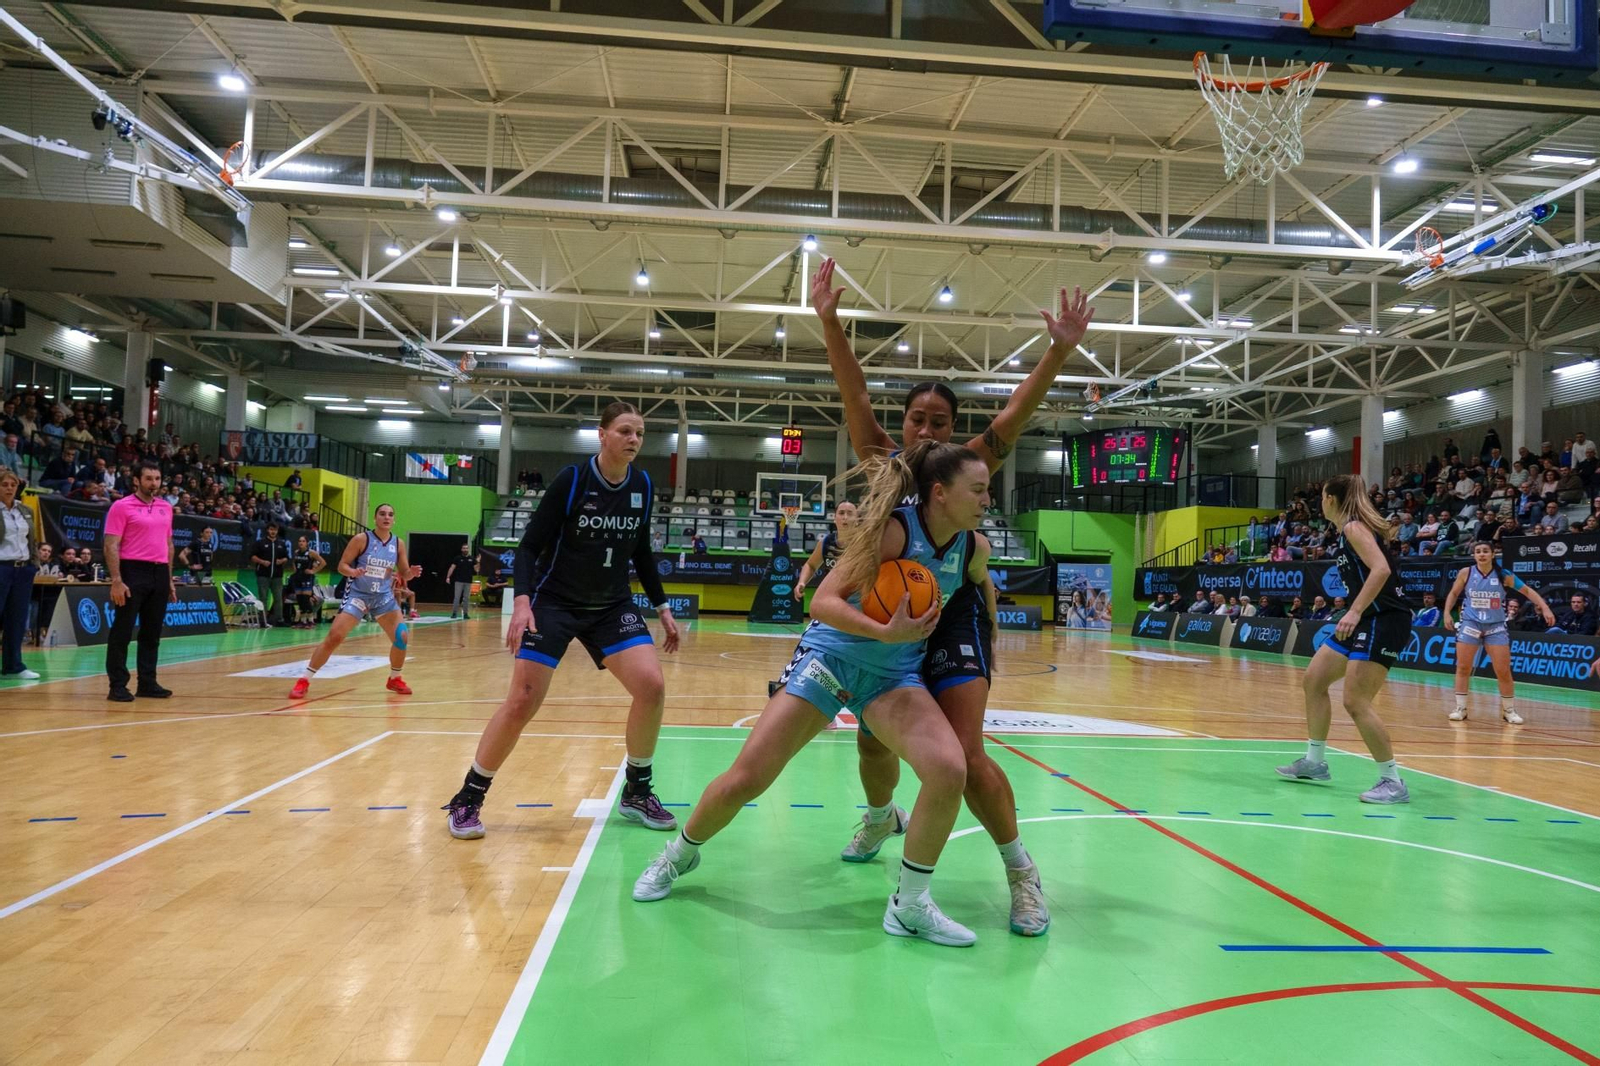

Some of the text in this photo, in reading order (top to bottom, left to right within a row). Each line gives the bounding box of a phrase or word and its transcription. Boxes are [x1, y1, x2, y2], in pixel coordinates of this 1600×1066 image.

[246, 433, 309, 447] CASCO
[783, 429, 801, 437] 07:34
[783, 439, 801, 453] 03
[246, 447, 307, 462] VELLO
[1110, 454, 1136, 465] 07:34
[62, 515, 100, 528] CONCELLO
[578, 515, 640, 530] DOMUSA
[66, 529, 95, 540] DE VIGO
[1573, 544, 1597, 552] Recalvi
[603, 548, 613, 567] 1
[1199, 574, 1240, 591] Vepersa
[1256, 566, 1303, 589] inteco
[1468, 588, 1500, 598] femxa
[188, 600, 216, 610] caminos
[1478, 611, 1486, 620] 11
[1511, 640, 1595, 660] BALONCESTO
[1509, 655, 1591, 680] FEMENINO
[810, 671, 832, 691] DE VIGO
[811, 663, 838, 688] CONCELLO
